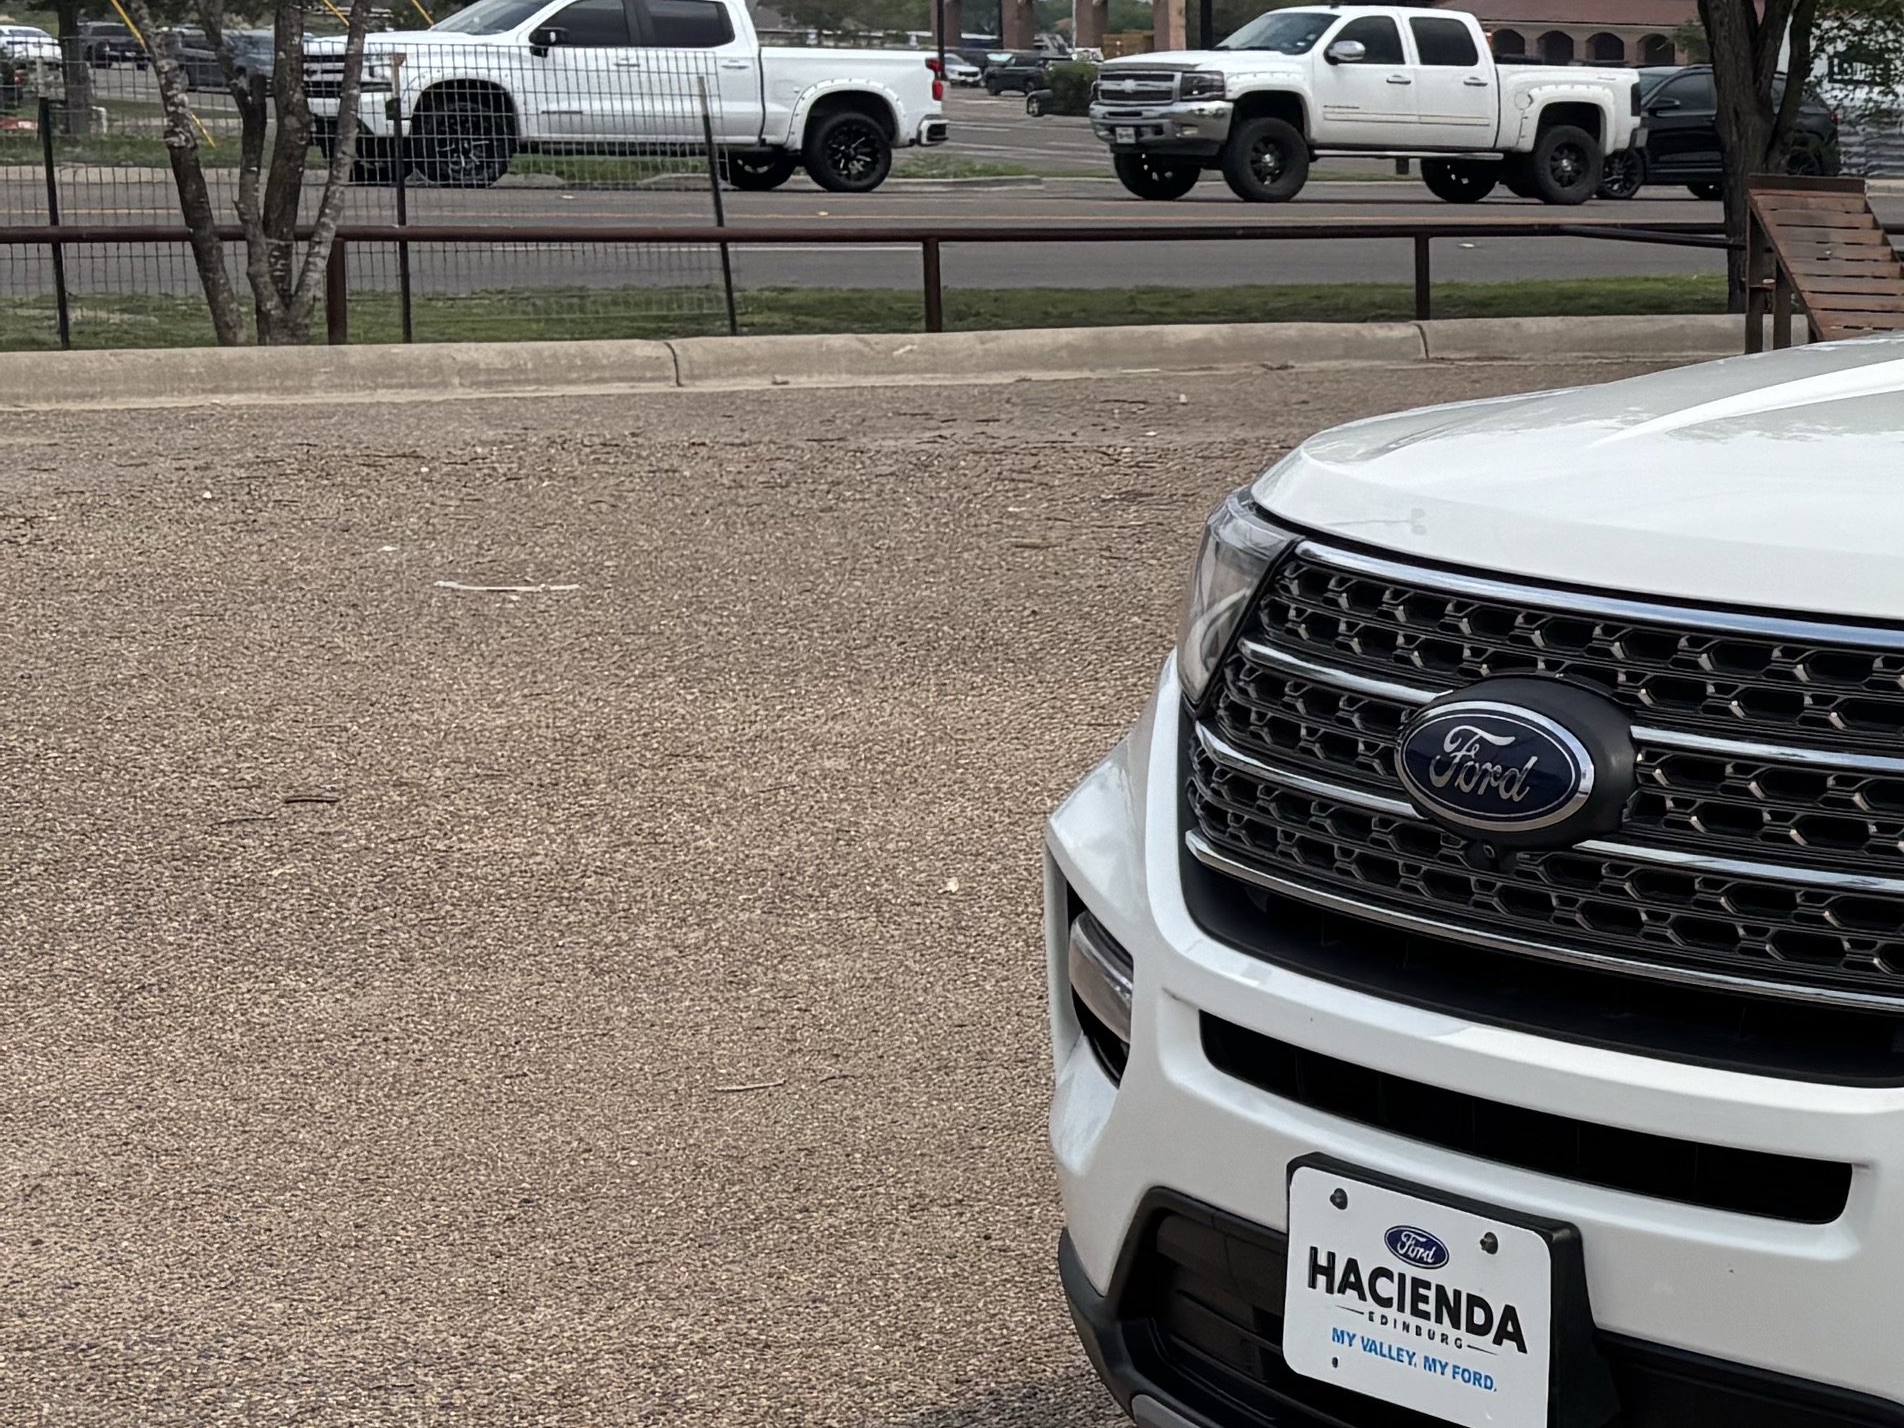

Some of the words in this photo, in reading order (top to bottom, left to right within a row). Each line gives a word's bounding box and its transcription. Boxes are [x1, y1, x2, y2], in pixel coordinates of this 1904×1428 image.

[1429, 724, 1539, 802] Ford
[1396, 1230, 1437, 1263] Ford
[1307, 1246, 1528, 1354] HACIENDA
[1368, 1311, 1463, 1349] EDINBURG
[1332, 1327, 1357, 1347] MY
[1423, 1355, 1449, 1376] MY
[1452, 1365, 1498, 1393] FORD.
